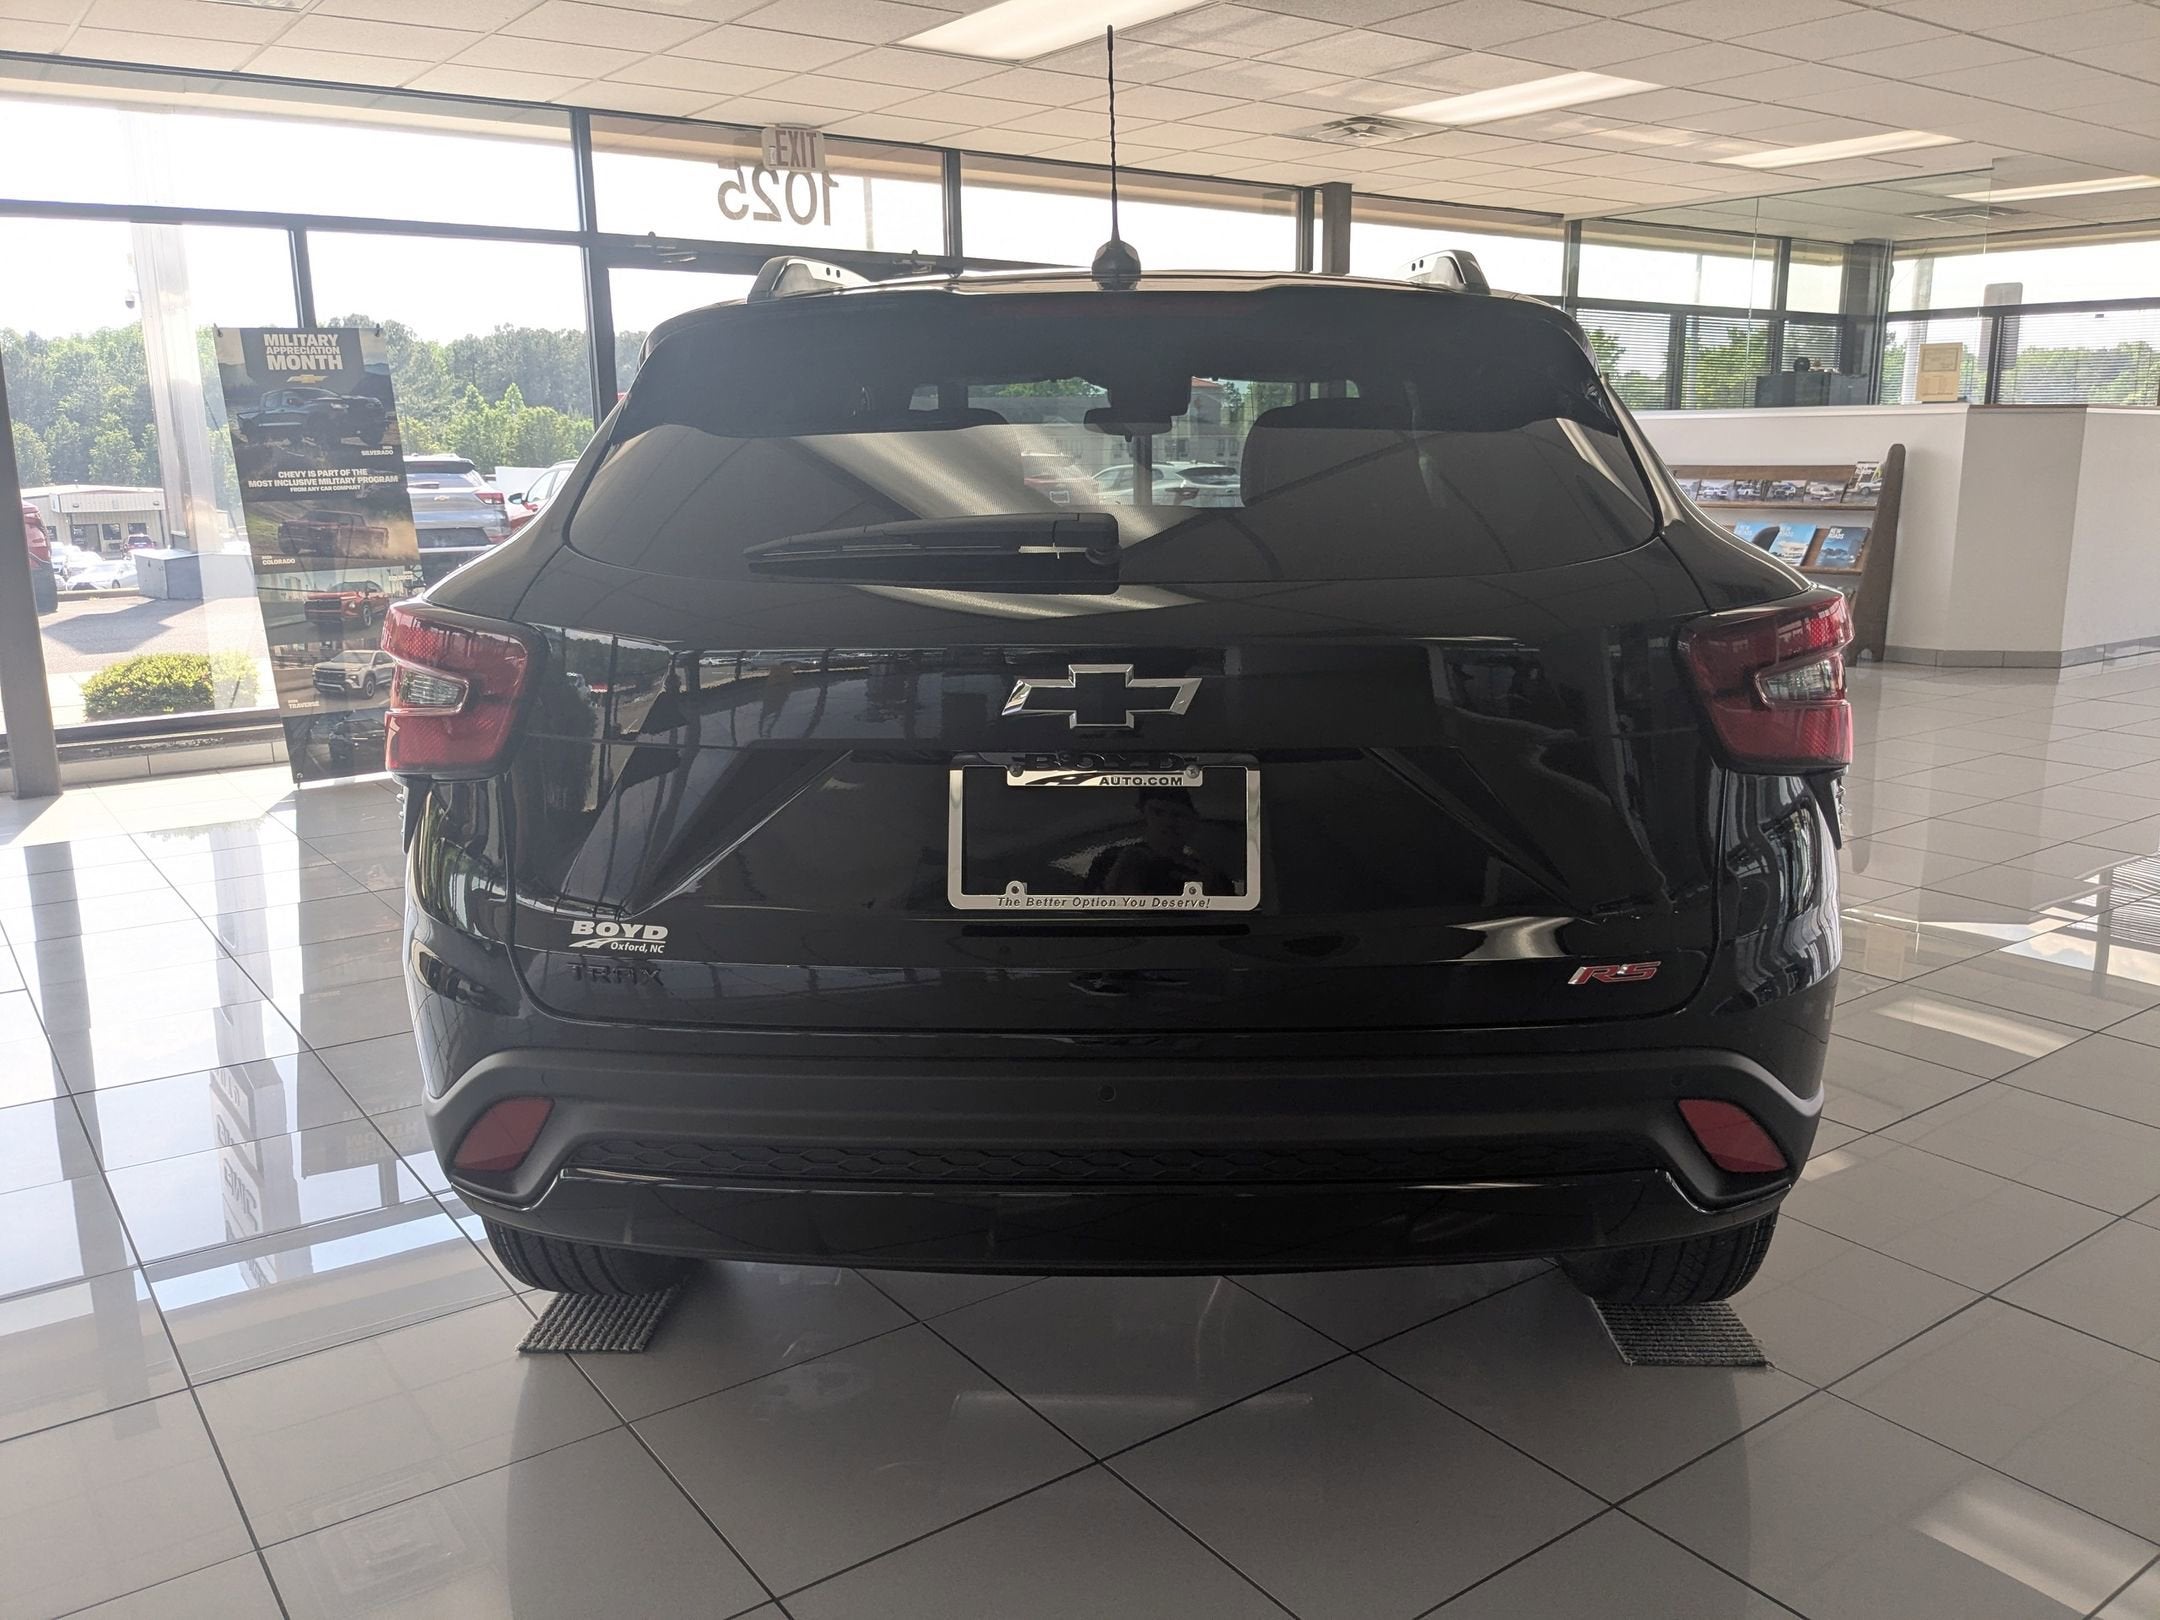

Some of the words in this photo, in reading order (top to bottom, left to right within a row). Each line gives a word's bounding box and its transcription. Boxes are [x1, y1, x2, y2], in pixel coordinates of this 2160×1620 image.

[775, 129, 817, 168] EXIT
[264, 334, 338, 347] MILITARY
[266, 346, 340, 355] APPRECIATION
[267, 354, 343, 370] MONTH
[317, 469, 339, 477] PART
[351, 468, 368, 476] THE
[248, 480, 273, 488] MOST
[274, 478, 318, 487] INCLUSIVE
[318, 477, 357, 486] MILITARY
[357, 475, 399, 484] PROGRAM
[1100, 776, 1183, 786] AUTO.COM
[998, 896, 1021, 907] The
[1026, 896, 1066, 908] Better
[1072, 896, 1116, 909] Option
[1122, 897, 1146, 908] You
[1151, 897, 1211, 908] Deserve!
[571, 920, 669, 940] BOYD
[610, 942, 648, 953] Oxford,
[650, 944, 665, 953] NC
[567, 962, 664, 987] TRAX
[1567, 961, 1662, 985] RS
